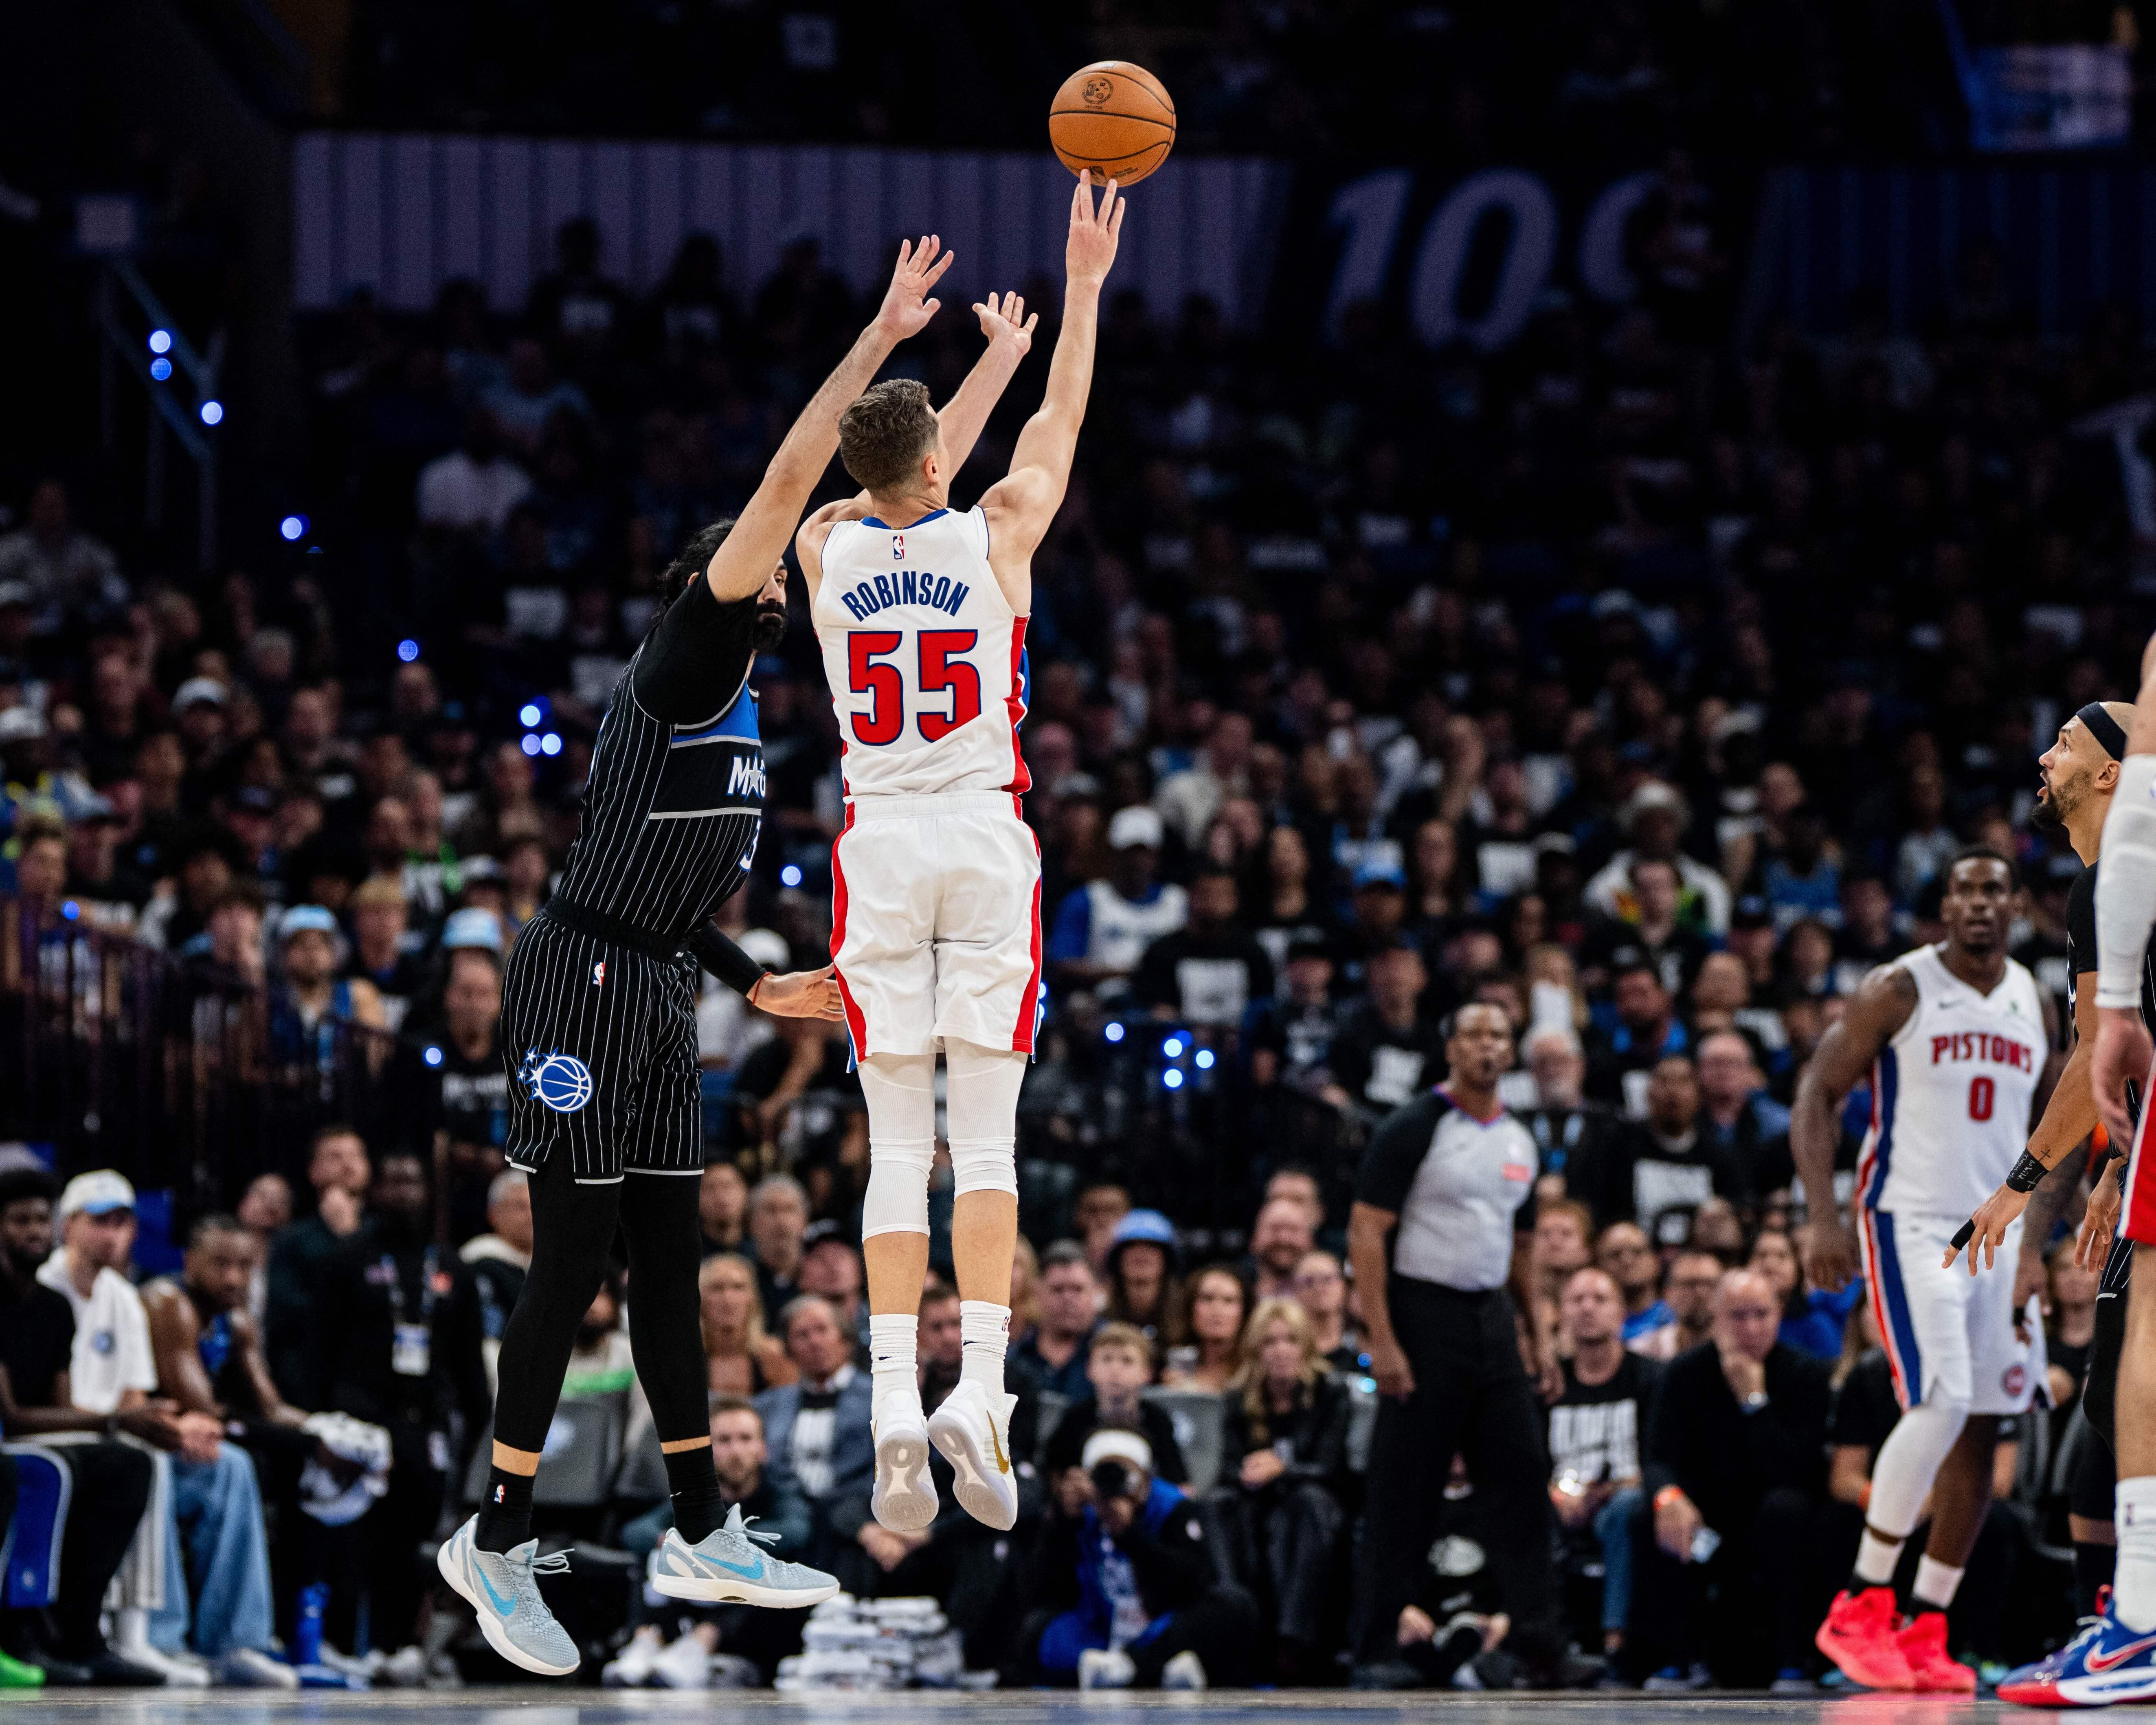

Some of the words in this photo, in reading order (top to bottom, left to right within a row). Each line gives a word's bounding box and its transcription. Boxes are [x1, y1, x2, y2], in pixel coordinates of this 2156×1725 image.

[841, 571, 969, 622] ROBINSON
[847, 629, 981, 747] 55
[1931, 1032, 2032, 1075] PISTONS
[1970, 1076, 1993, 1121] 0
